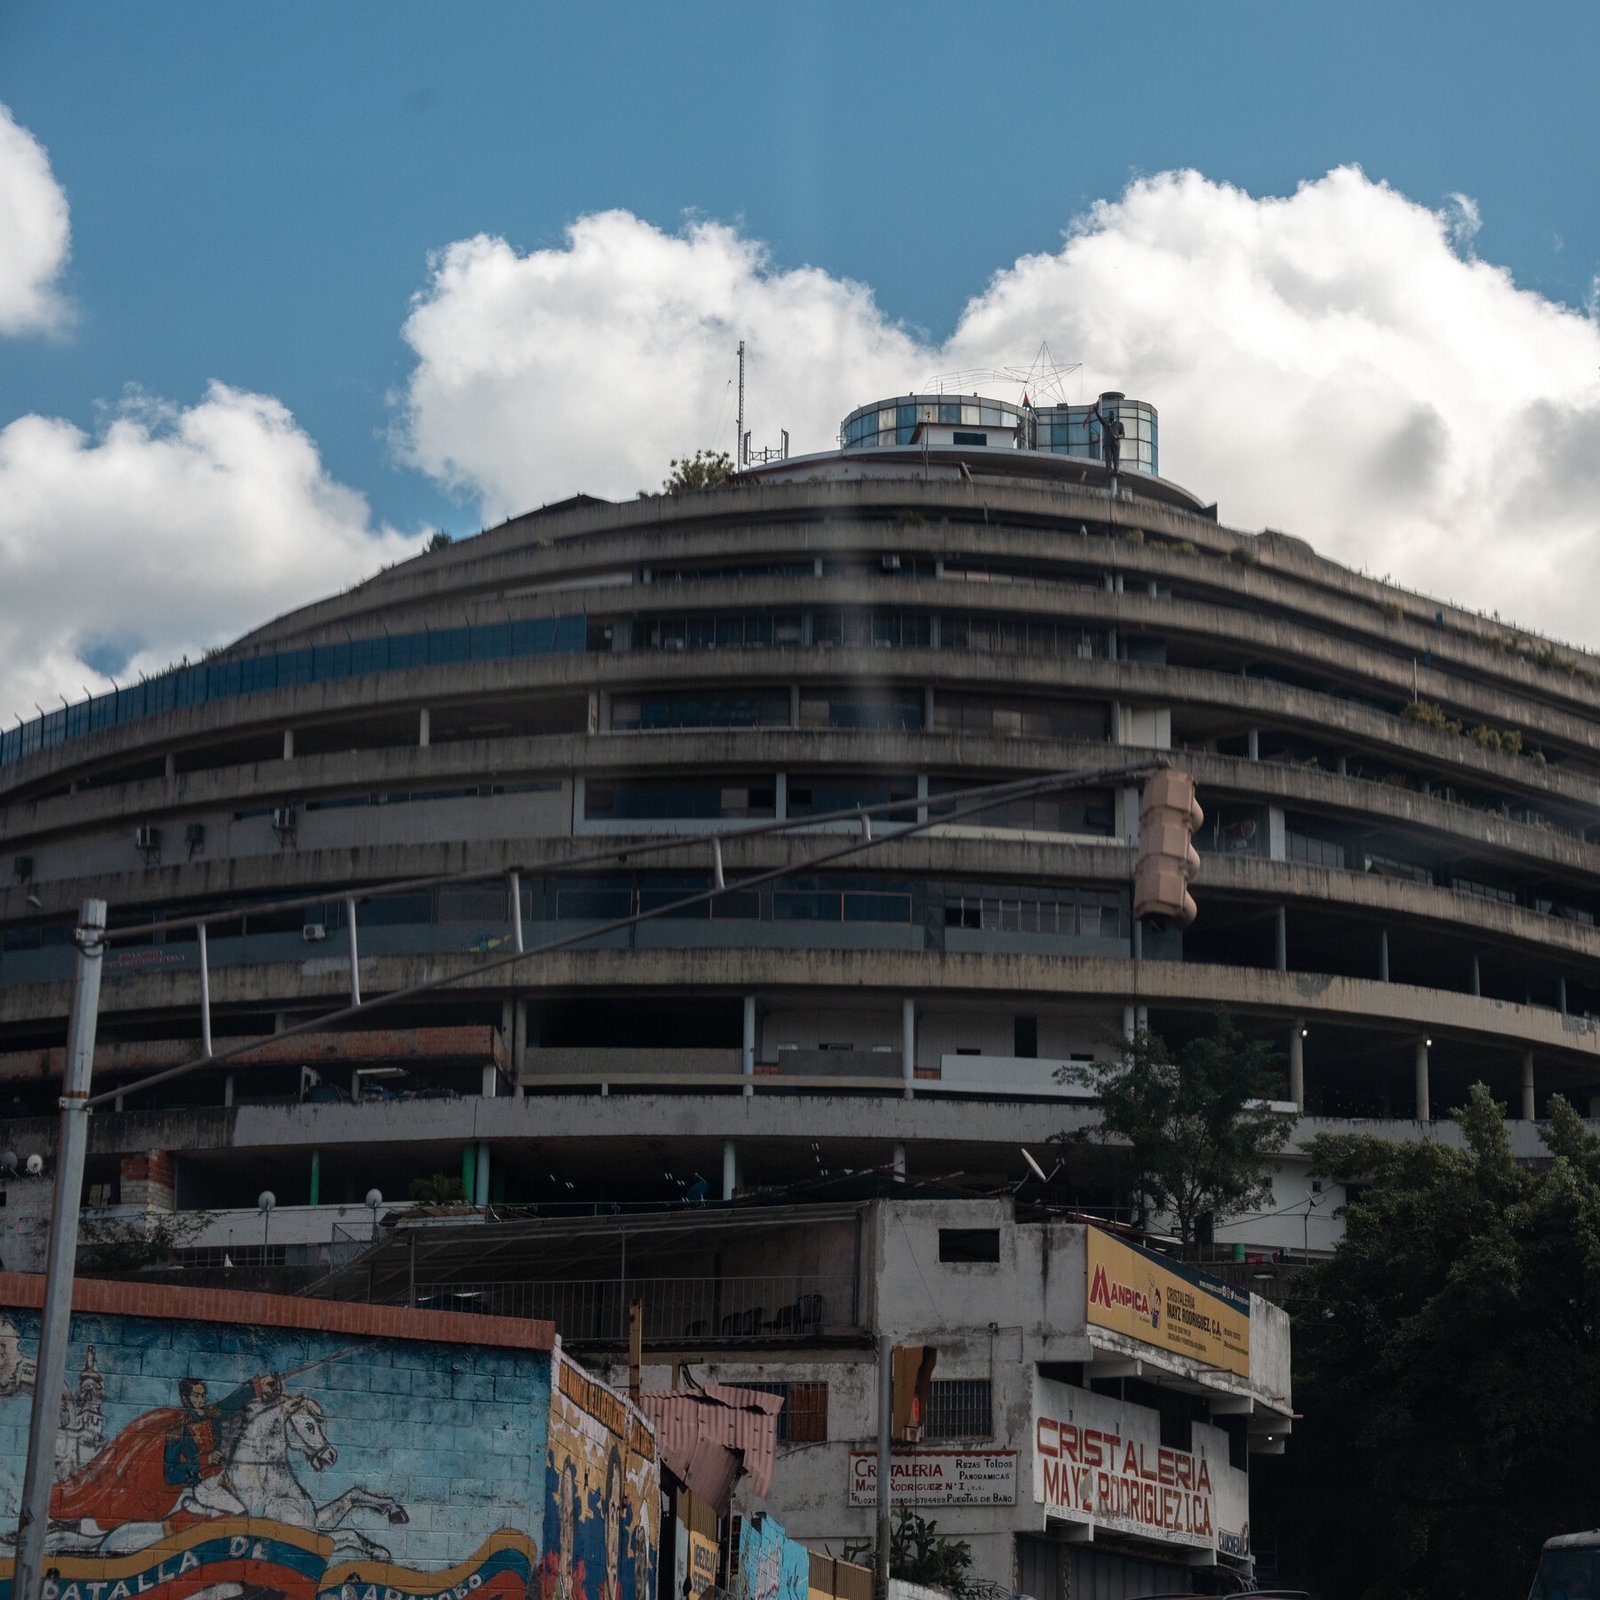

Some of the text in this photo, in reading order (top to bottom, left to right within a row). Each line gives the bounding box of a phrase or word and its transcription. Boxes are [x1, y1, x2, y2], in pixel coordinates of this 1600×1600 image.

[1089, 1263, 1150, 1315] MANPICA
[1167, 1303, 1182, 1323] MAYZ
[956, 1459, 981, 1468] REJAS
[1037, 1416, 1212, 1494] CRISTALERIA
[855, 1459, 943, 1477] CRTALERIA
[959, 1471, 1010, 1480] PANORAMICAS
[856, 1479, 877, 1491] MAY
[947, 1493, 978, 1503] PUERTAS
[993, 1493, 1012, 1503] BAÑO
[1098, 1471, 1183, 1531] RODRIGUEZ
[40, 1551, 201, 1600] BATALLA
